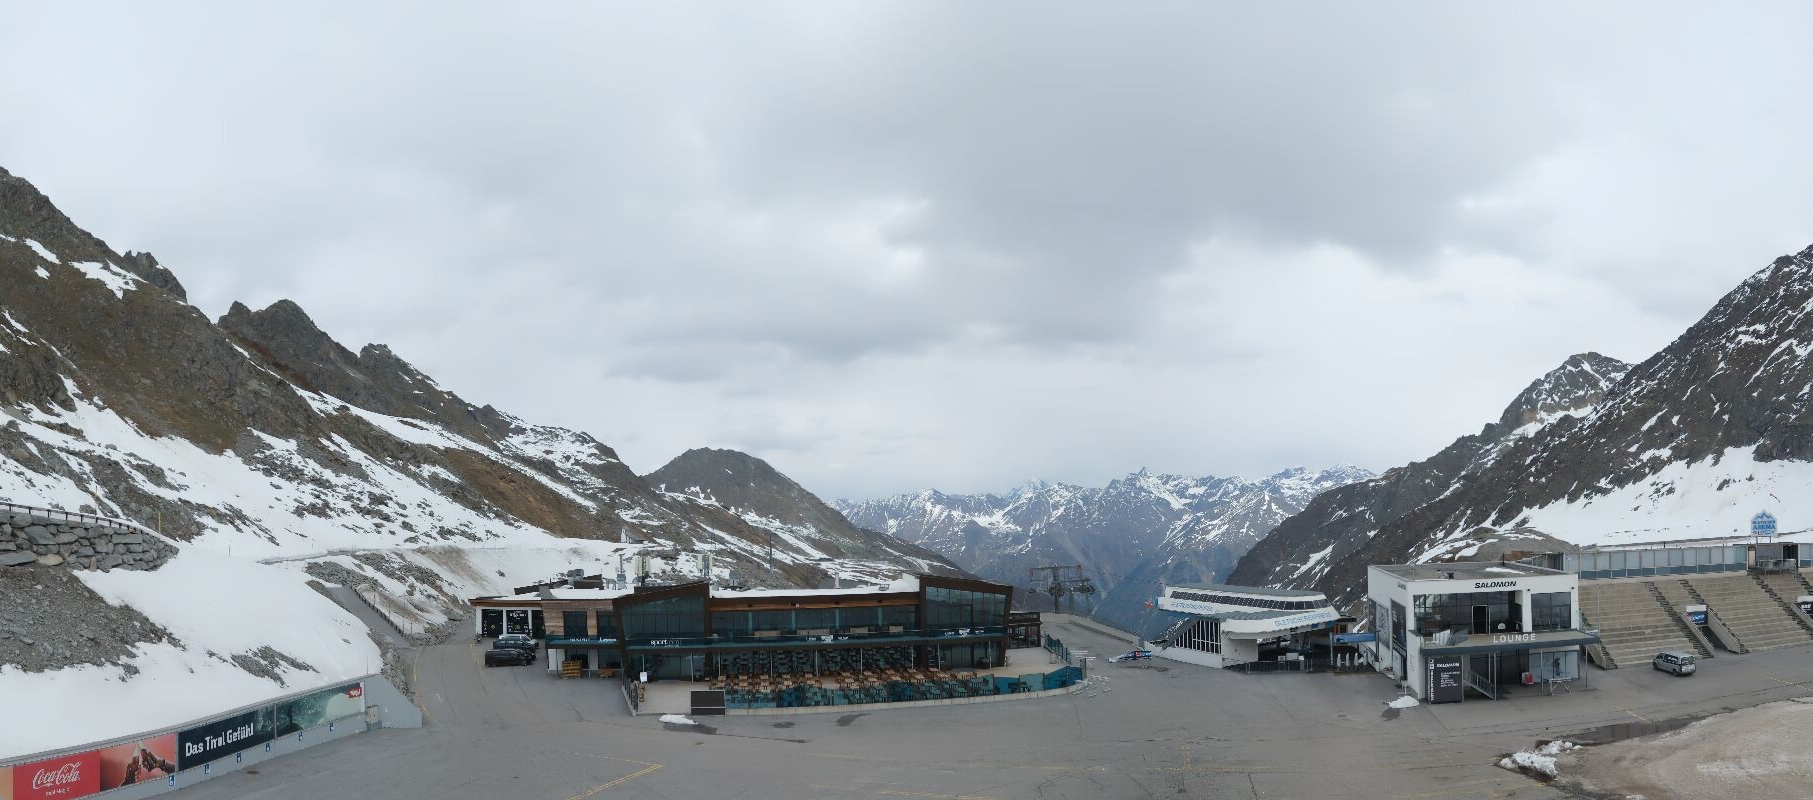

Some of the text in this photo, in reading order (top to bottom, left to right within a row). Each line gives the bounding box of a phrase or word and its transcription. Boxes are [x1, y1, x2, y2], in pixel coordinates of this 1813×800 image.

[1474, 580, 1517, 589] SALOMON
[1493, 633, 1536, 643] LOUNGE
[185, 722, 255, 757] Das Tirol Gefühl
